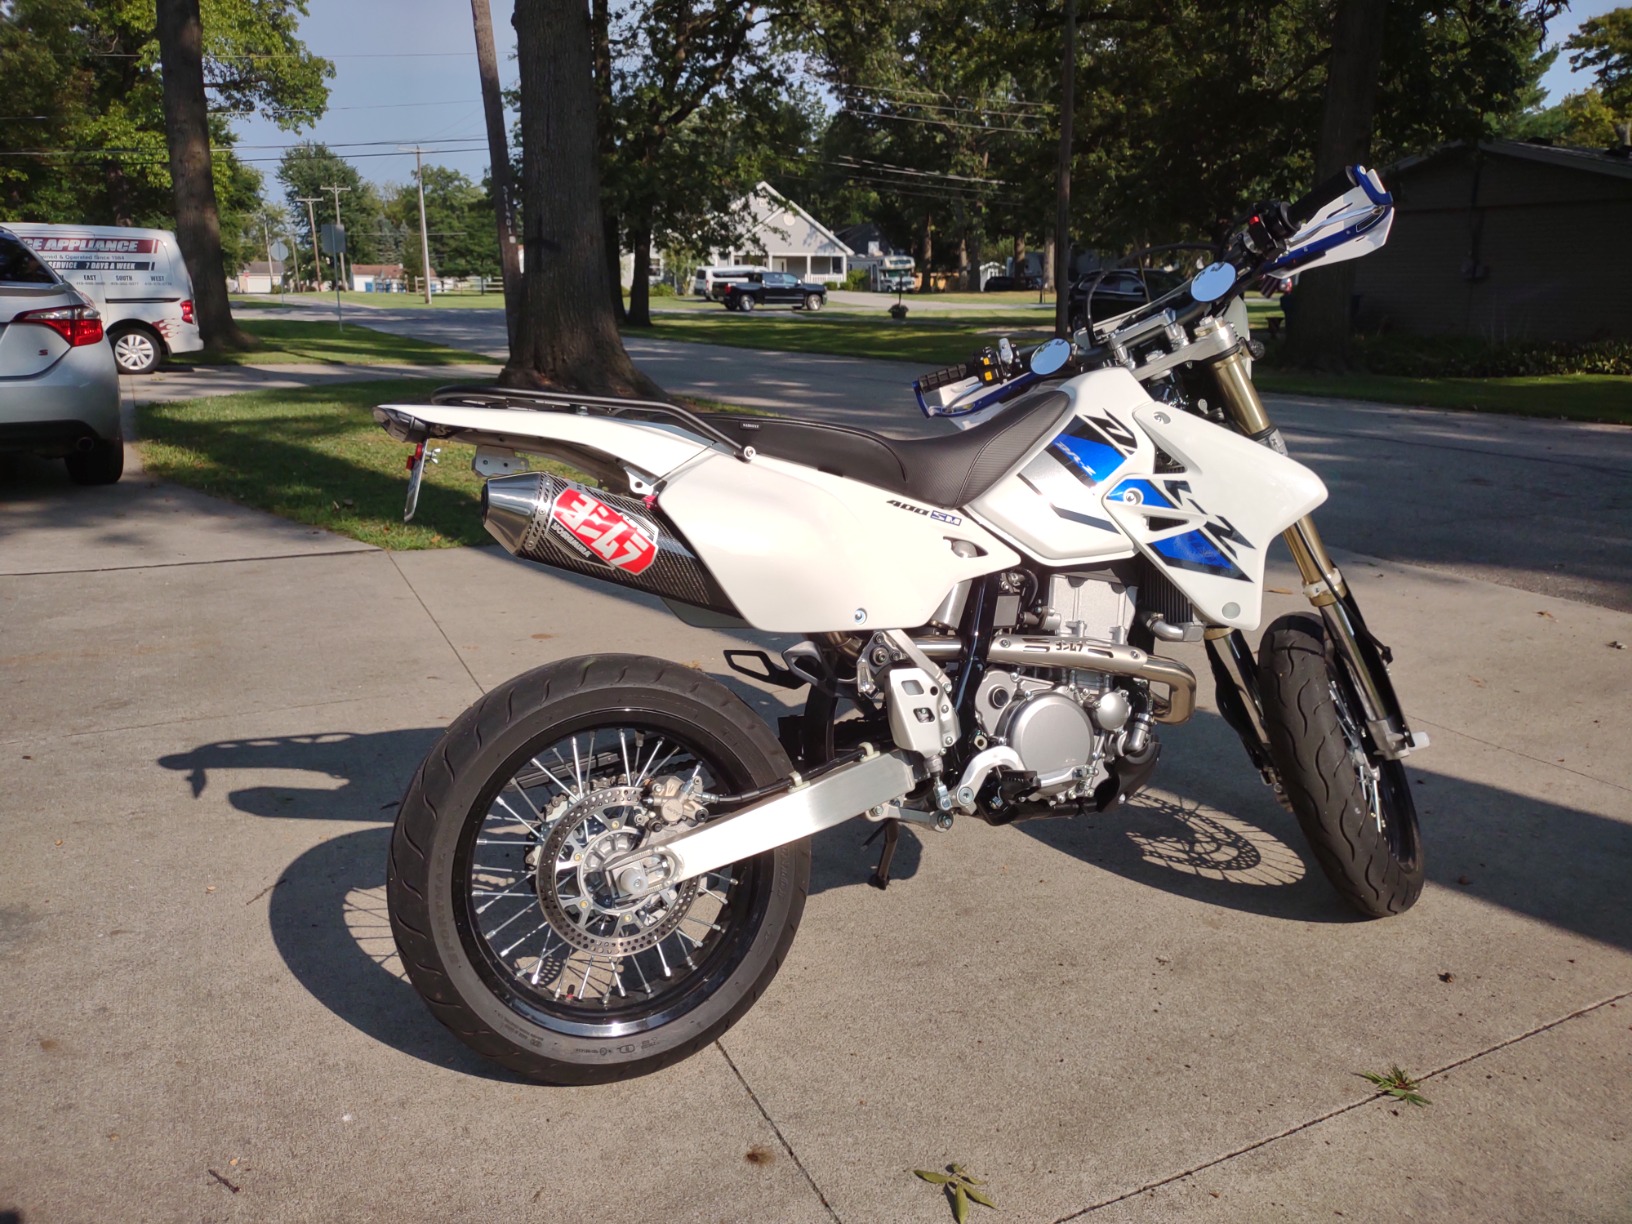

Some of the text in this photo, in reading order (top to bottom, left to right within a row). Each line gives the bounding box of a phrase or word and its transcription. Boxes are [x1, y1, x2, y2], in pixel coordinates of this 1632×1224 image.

[44, 239, 139, 252] APPLIANCE
[48, 261, 78, 270] SERVICE
[90, 262, 110, 270] DAYS
[116, 262, 136, 270] WEEK
[886, 500, 962, 526] 400 SM
[551, 522, 592, 558] YOSHIMURA
